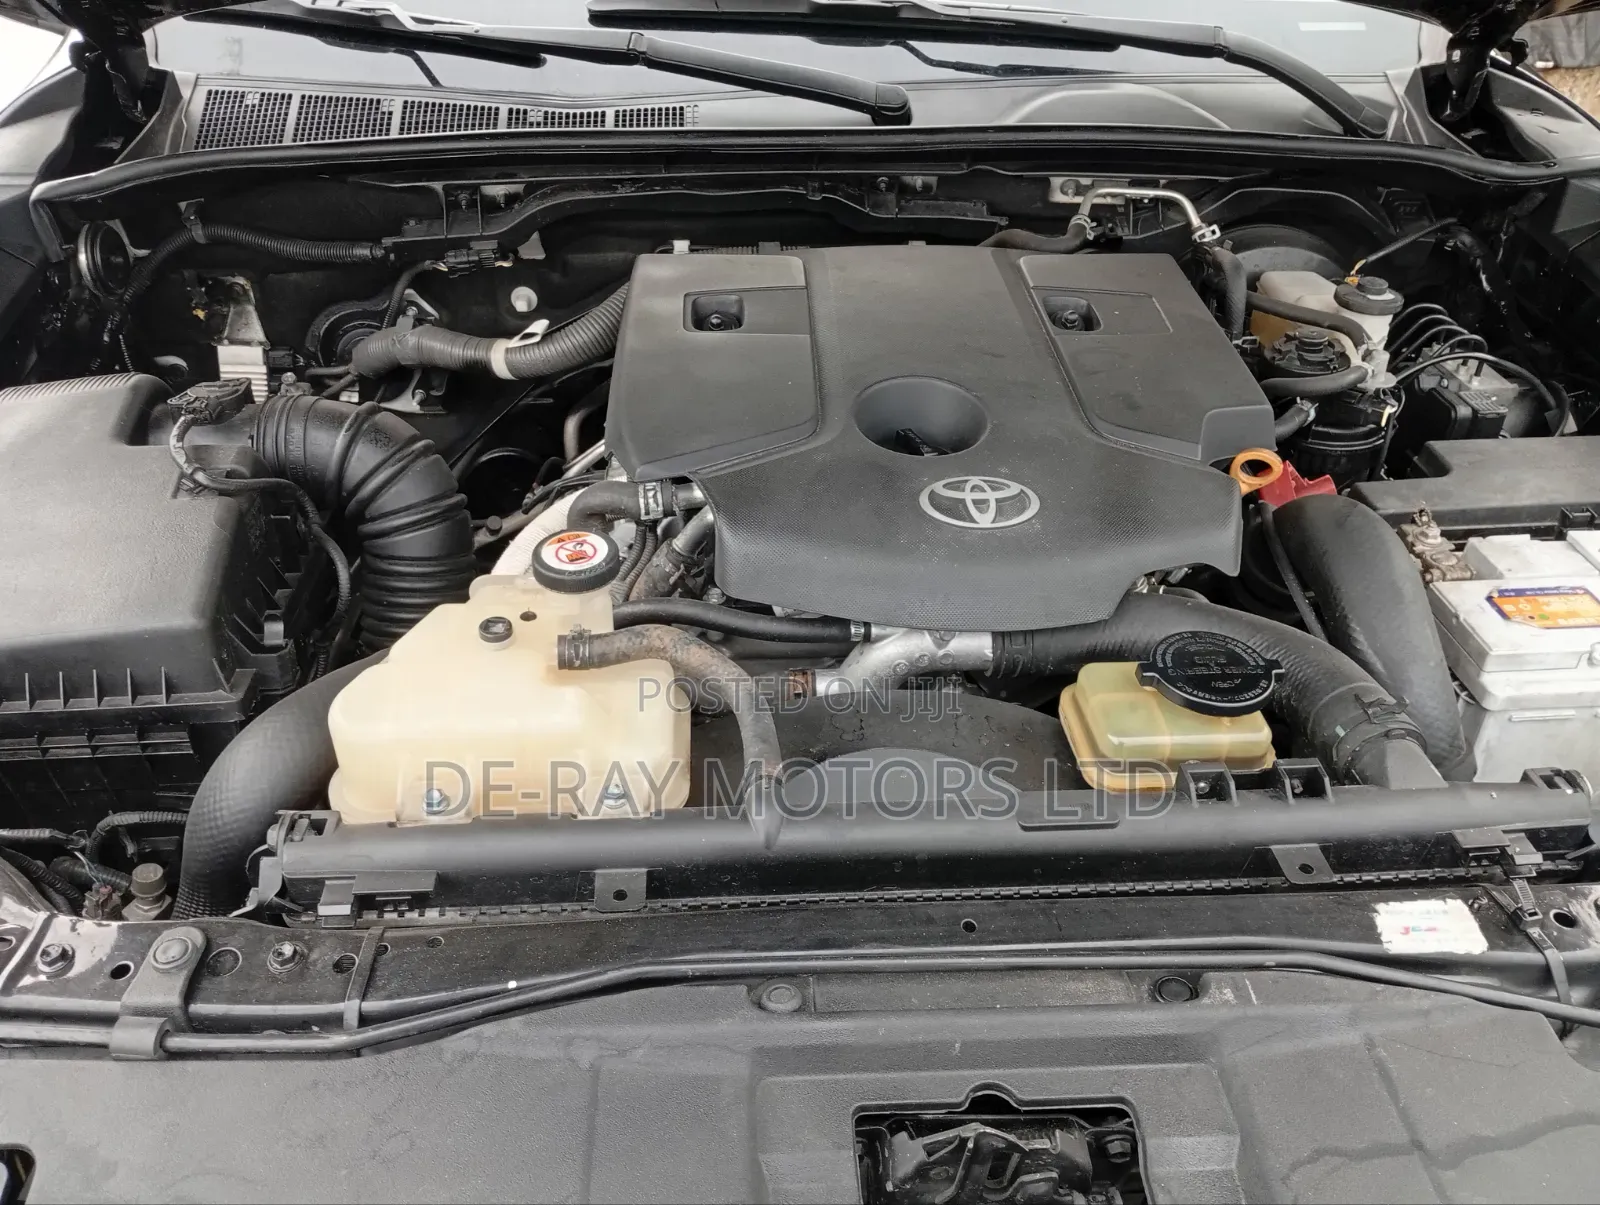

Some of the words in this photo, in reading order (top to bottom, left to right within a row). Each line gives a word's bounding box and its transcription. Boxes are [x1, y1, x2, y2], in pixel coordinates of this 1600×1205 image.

[1167, 665, 1222, 676] STEERING
[1223, 665, 1265, 674] POWER
[1211, 680, 1235, 688] OPEN
